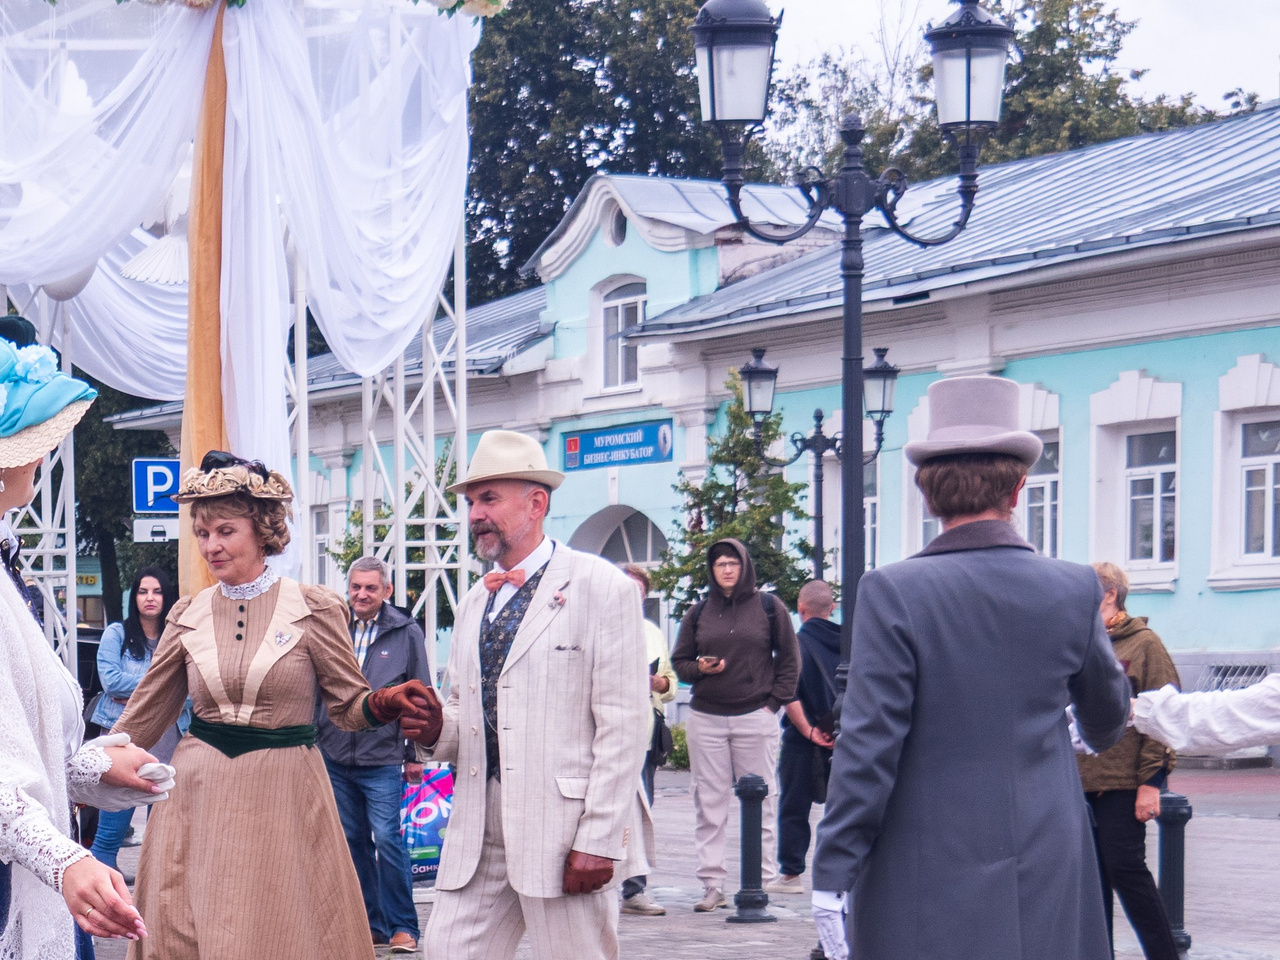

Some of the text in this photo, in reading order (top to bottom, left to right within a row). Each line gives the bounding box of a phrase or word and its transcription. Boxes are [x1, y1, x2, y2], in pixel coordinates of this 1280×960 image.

[594, 430, 644, 448] МУРОМСКИЙ
[583, 446, 654, 465] БИЗНЕС-ИНКУБАТОР
[147, 465, 174, 507] P
[411, 863, 439, 875] банк
